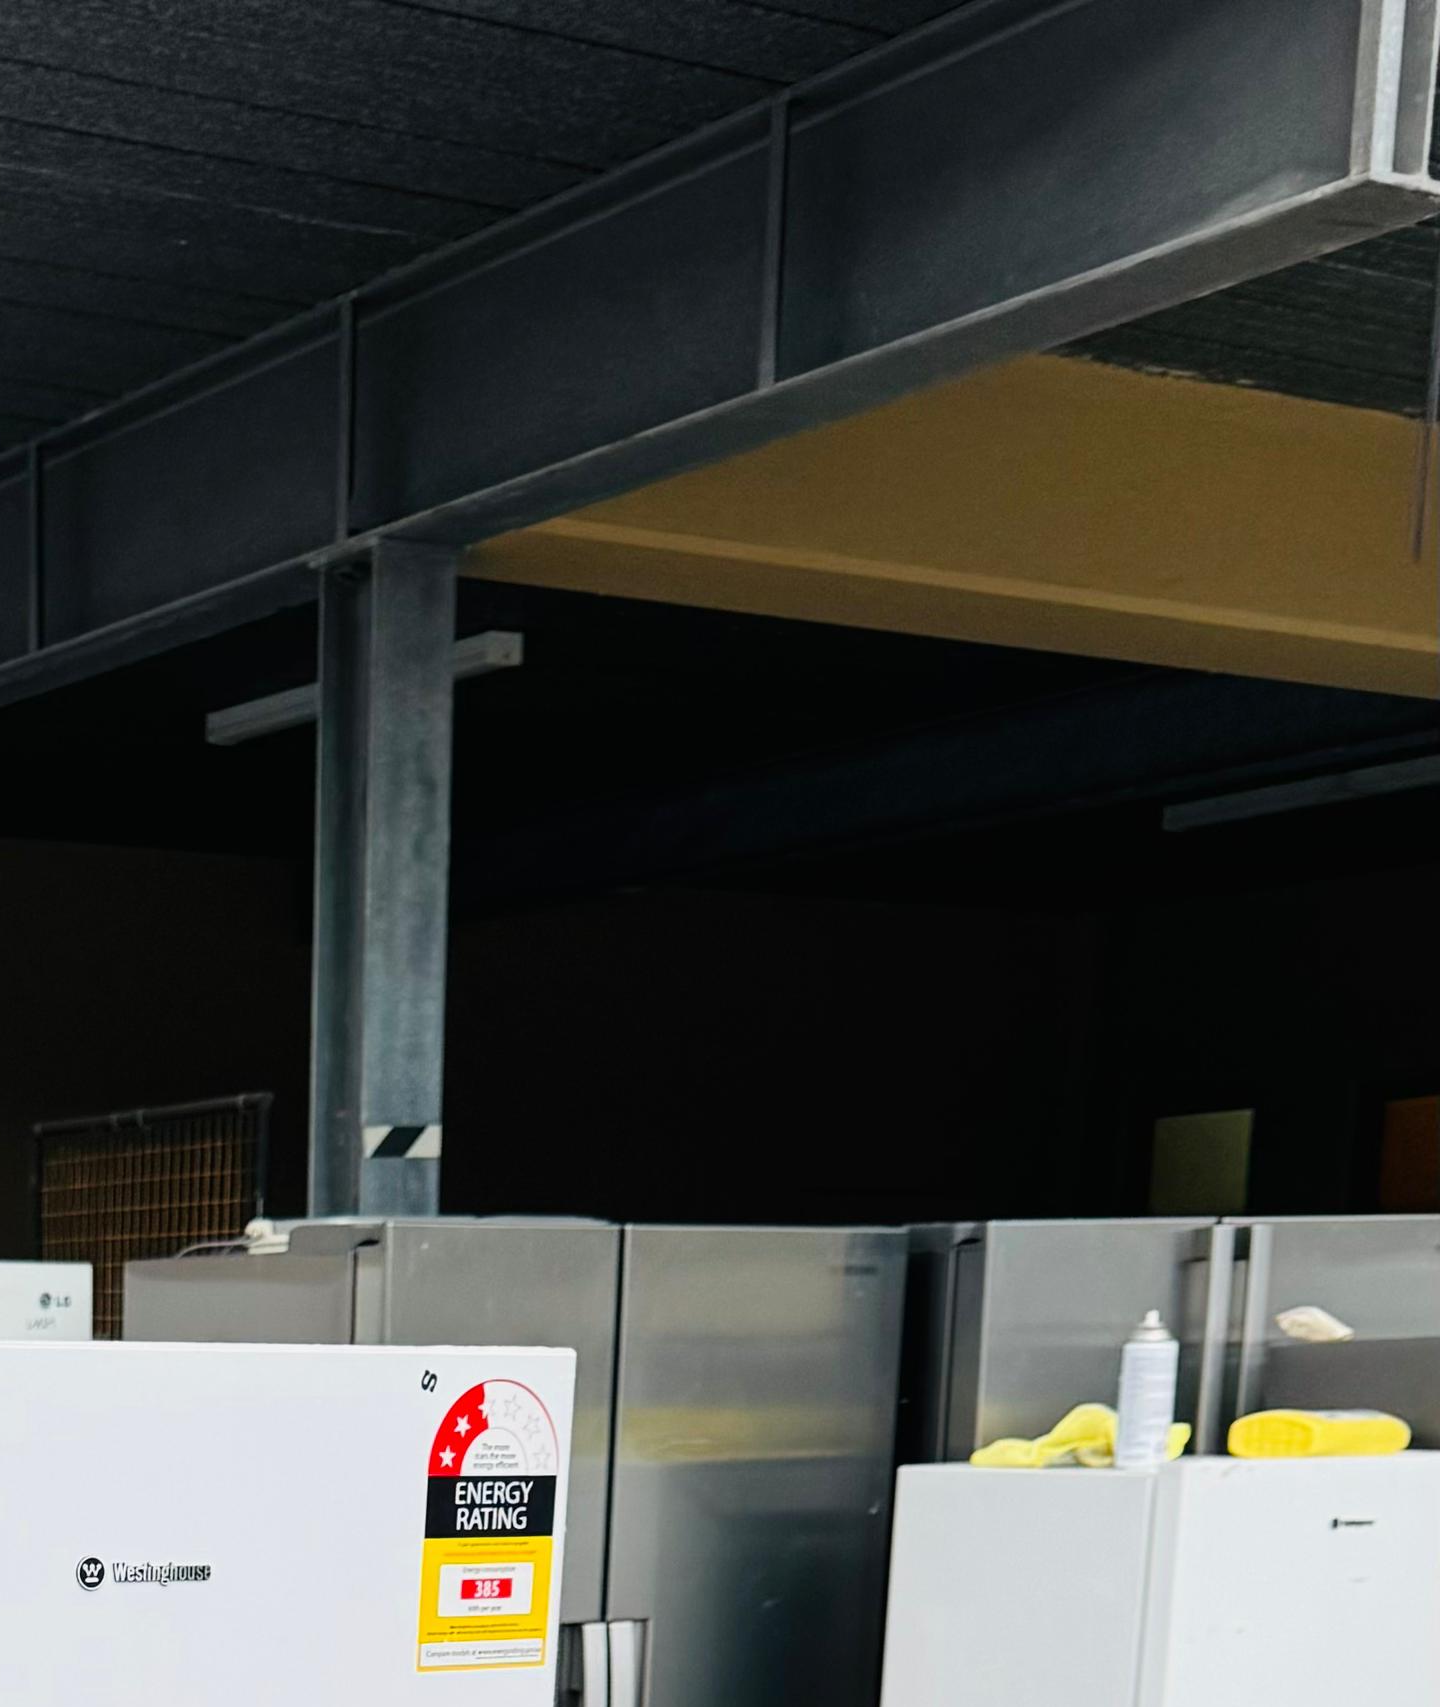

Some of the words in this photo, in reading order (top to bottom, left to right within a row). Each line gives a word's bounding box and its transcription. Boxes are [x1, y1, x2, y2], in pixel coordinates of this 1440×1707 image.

[454, 1481, 534, 1505] ENERGY
[456, 1506, 528, 1531] RATING
[112, 1561, 212, 1587] Westinghouse
[474, 1579, 501, 1599] 385
